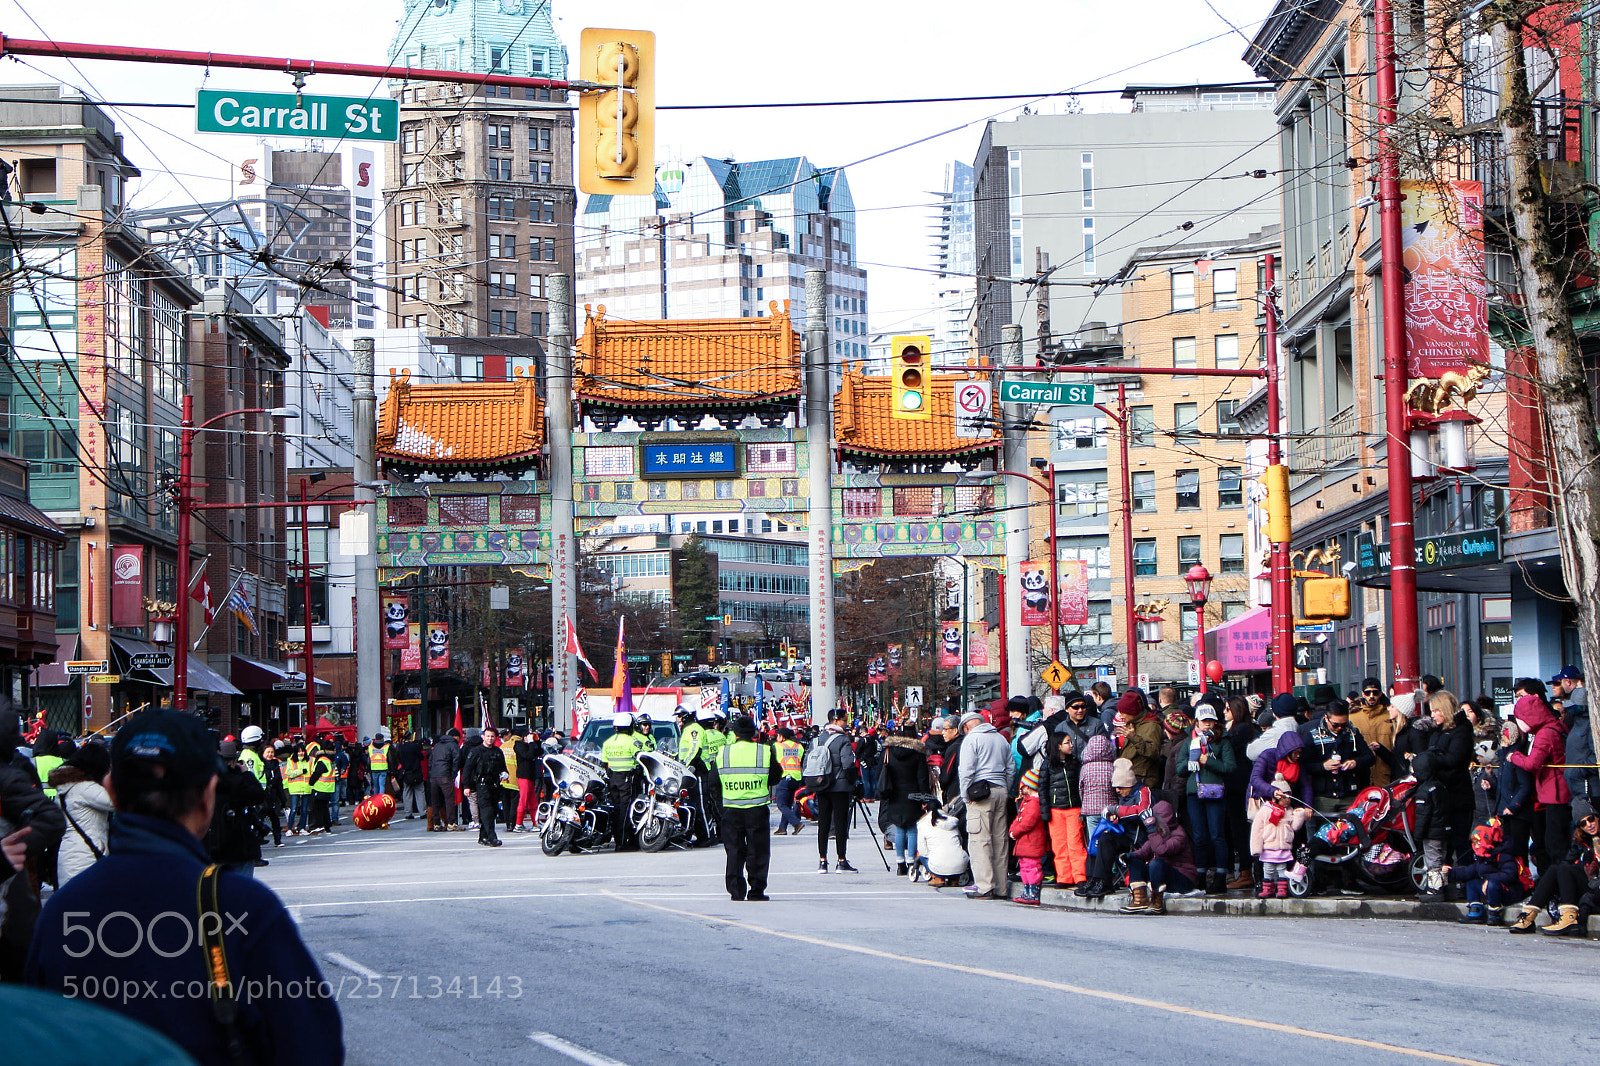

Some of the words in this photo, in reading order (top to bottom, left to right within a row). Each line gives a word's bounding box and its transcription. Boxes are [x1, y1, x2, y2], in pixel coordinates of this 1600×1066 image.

[213, 97, 328, 131] Carrall
[344, 103, 383, 134] St
[1008, 384, 1063, 401] Carrall
[1068, 387, 1088, 402] St
[1490, 635, 1508, 643] West
[724, 780, 763, 791] SECURITY
